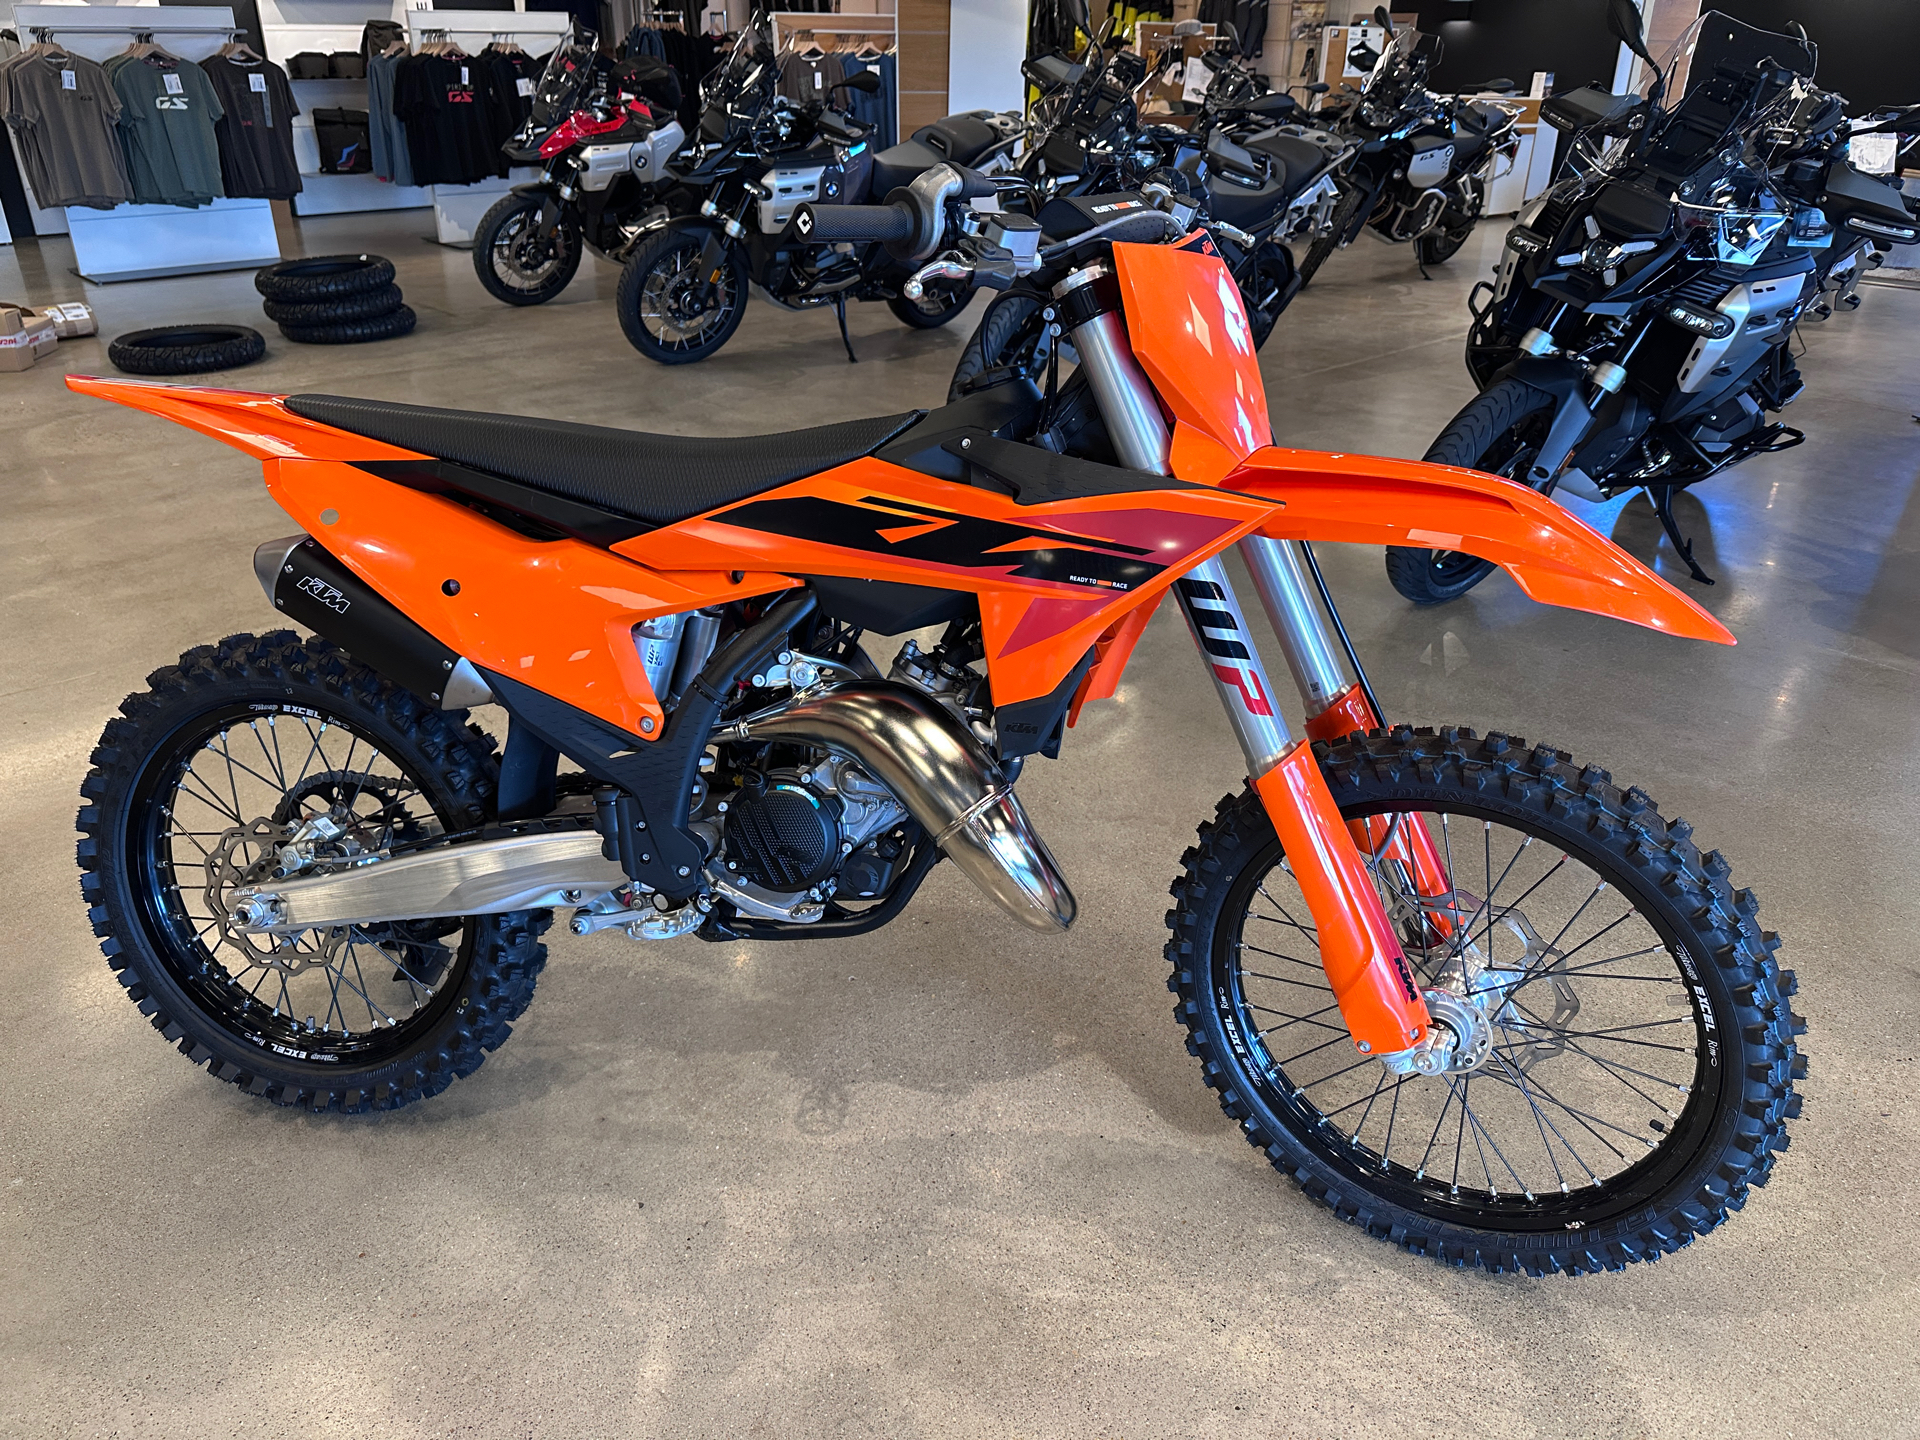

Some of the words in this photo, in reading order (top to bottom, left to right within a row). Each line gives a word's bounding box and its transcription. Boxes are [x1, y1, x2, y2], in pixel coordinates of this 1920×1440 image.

[155, 96, 189, 110] GS
[448, 91, 474, 103] GS
[1420, 152, 1435, 161] GS
[1201, 239, 1214, 255] KTM
[1069, 575, 1089, 583] READY
[1112, 581, 1128, 590] RACE
[296, 576, 351, 614] KTM
[282, 704, 322, 720] EXCEL
[1004, 722, 1039, 735] KTM
[1394, 957, 1418, 1002] KTM
[1693, 985, 1715, 1032] EXCEL
[1224, 1015, 1245, 1054] EXCEL
[270, 1042, 307, 1060] EXCEL
